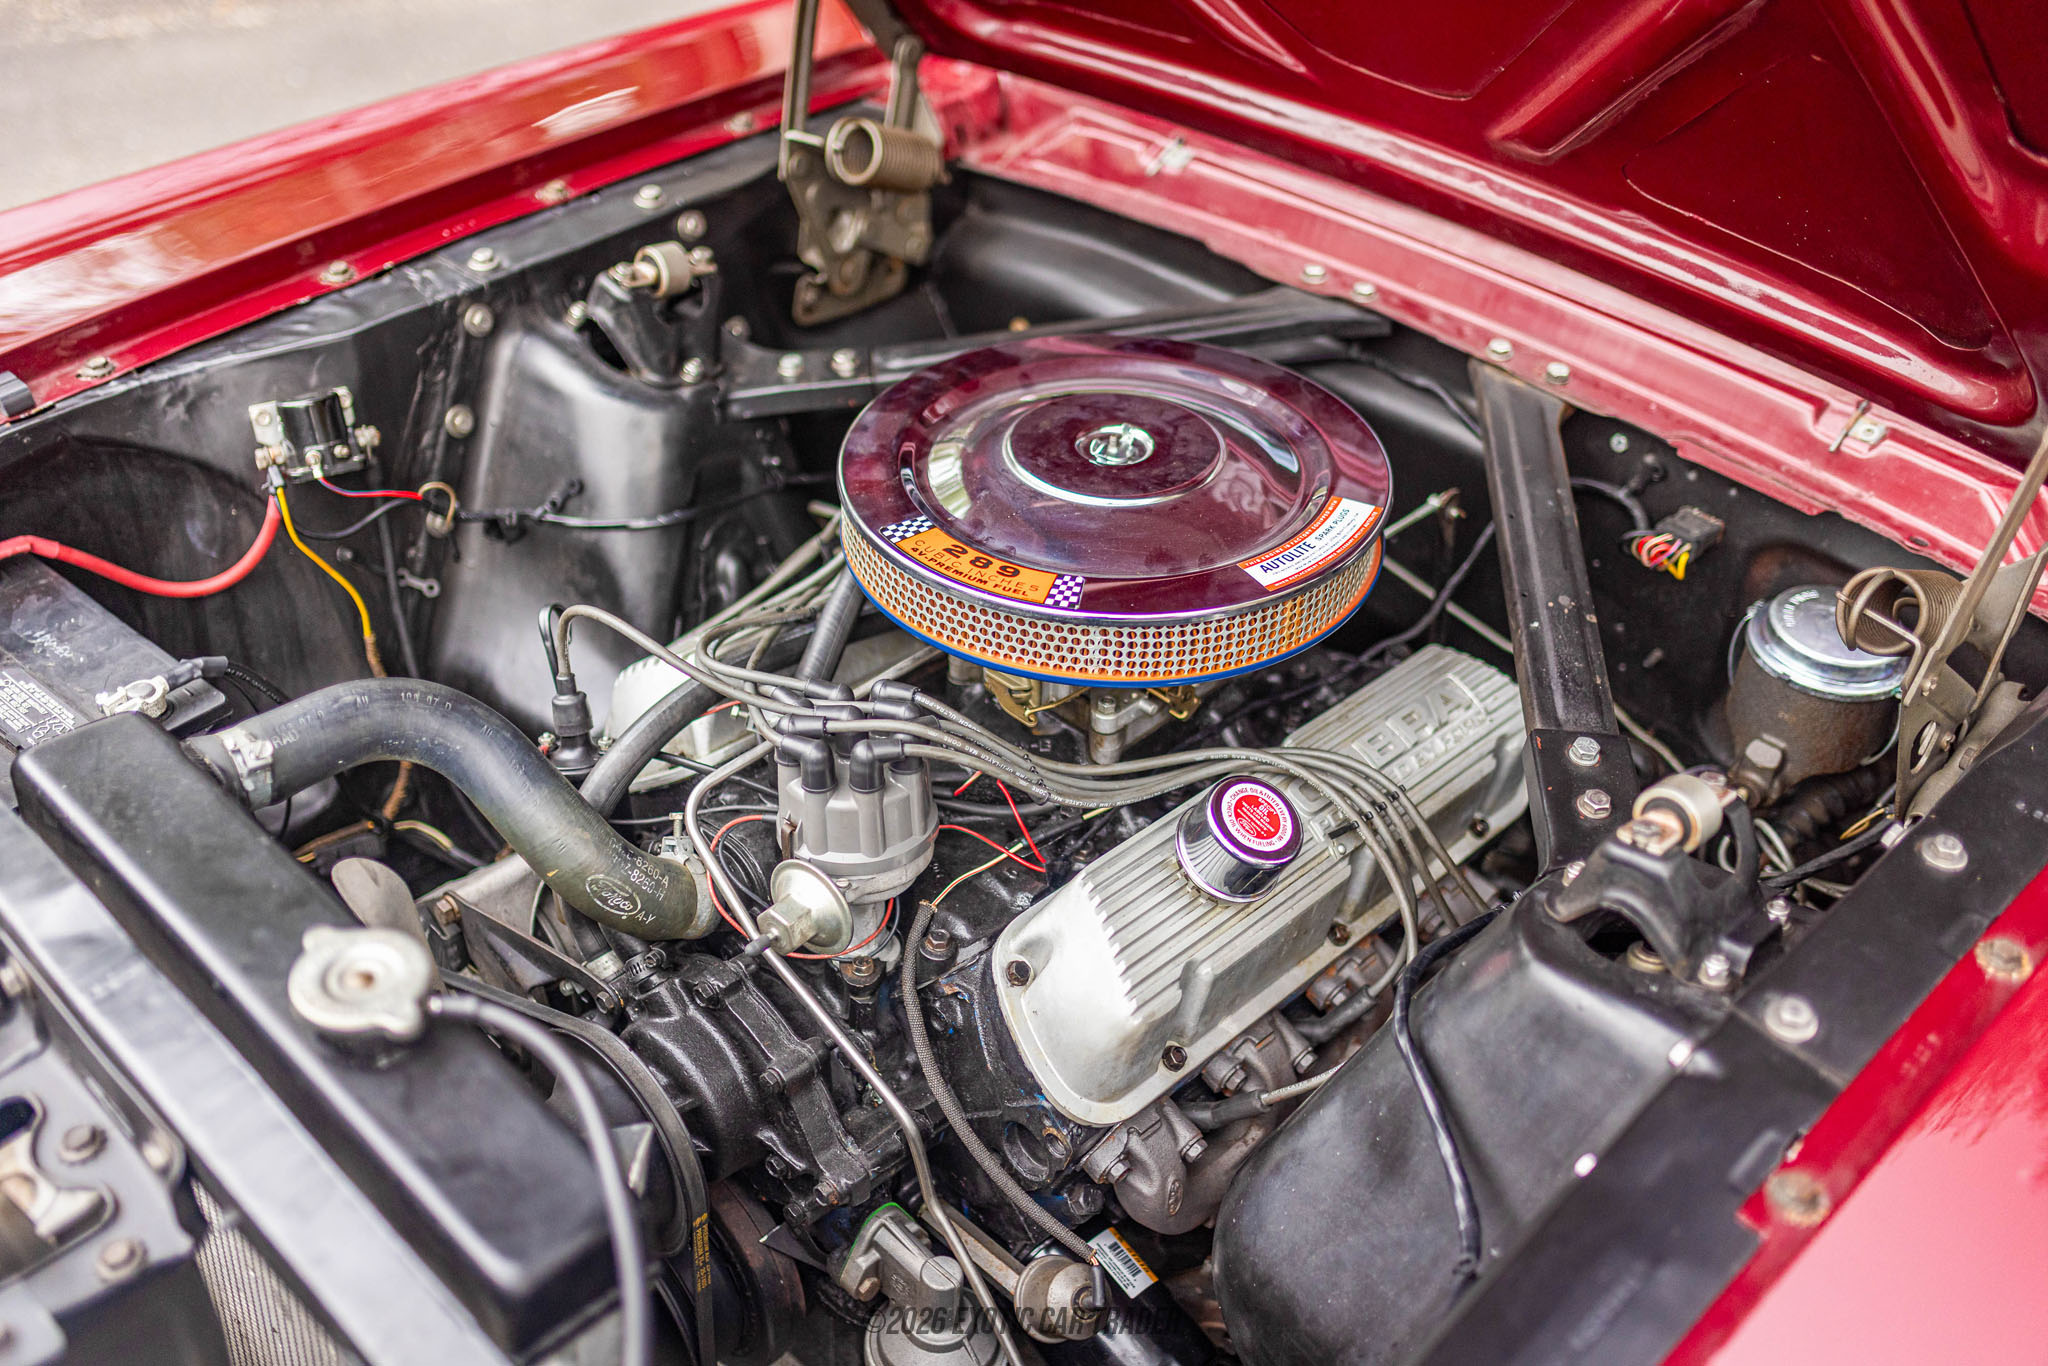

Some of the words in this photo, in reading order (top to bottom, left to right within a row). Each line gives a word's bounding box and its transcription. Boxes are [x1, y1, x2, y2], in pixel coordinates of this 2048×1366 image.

[1244, 559, 1261, 568] THIS
[1261, 547, 1283, 560] ENGINE
[1290, 528, 1312, 546] FACTORY
[1312, 509, 1330, 532] EQUIPPED
[1259, 541, 1316, 574] AUTOLITE
[1314, 524, 1334, 542] SPARK
[1333, 508, 1350, 525] PLUGS
[911, 547, 988, 586] 4V-PREMIUM
[993, 583, 1029, 598] FUEL
[914, 539, 963, 569] CUBIC
[967, 568, 1040, 592] INCHES
[943, 544, 1020, 578] 289
[1289, 563, 1319, 581] REPLACEMENT
[1319, 552, 1337, 566] BECOMES
[943, 736, 962, 747] CORE
[1251, 804, 1270, 823] LABELED
[1258, 804, 1268, 816] OIL
